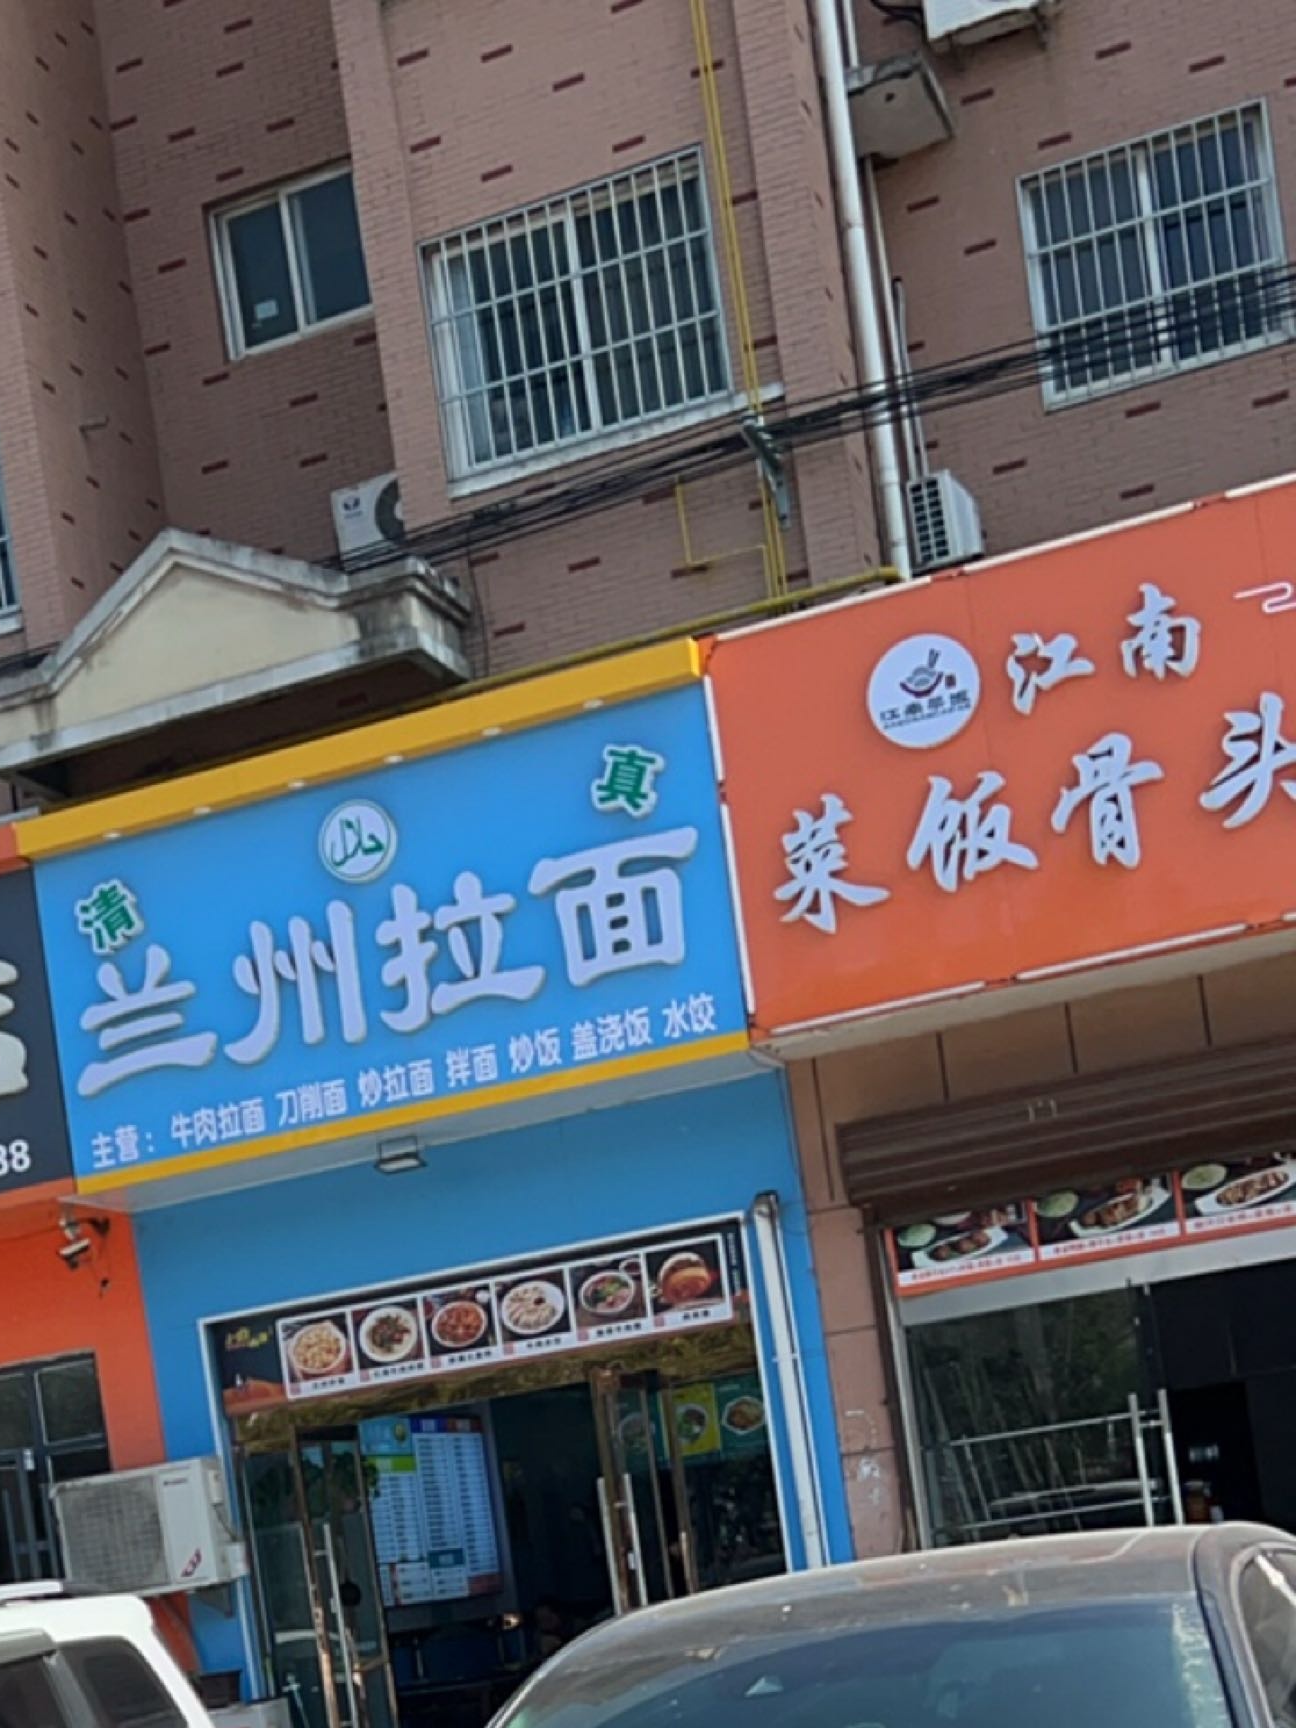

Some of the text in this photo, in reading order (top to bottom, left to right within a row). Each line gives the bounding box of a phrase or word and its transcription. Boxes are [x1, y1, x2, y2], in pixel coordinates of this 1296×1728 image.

[1006, 583, 1201, 716] 江南
[593, 744, 663, 817] 真
[774, 692, 1296, 934] 菜饭骨头
[77, 880, 144, 954] 清
[77, 826, 698, 1096] 兰州拉面
[170, 1096, 266, 1148] 牛肉拉面
[276, 1080, 346, 1126] 刀削面
[357, 1058, 434, 1108] 炒拉面
[446, 1044, 498, 1089] 拌面
[509, 1027, 562, 1073] 炒饭
[571, 1007, 652, 1060] 盖浇饭
[662, 992, 717, 1040] 水饺
